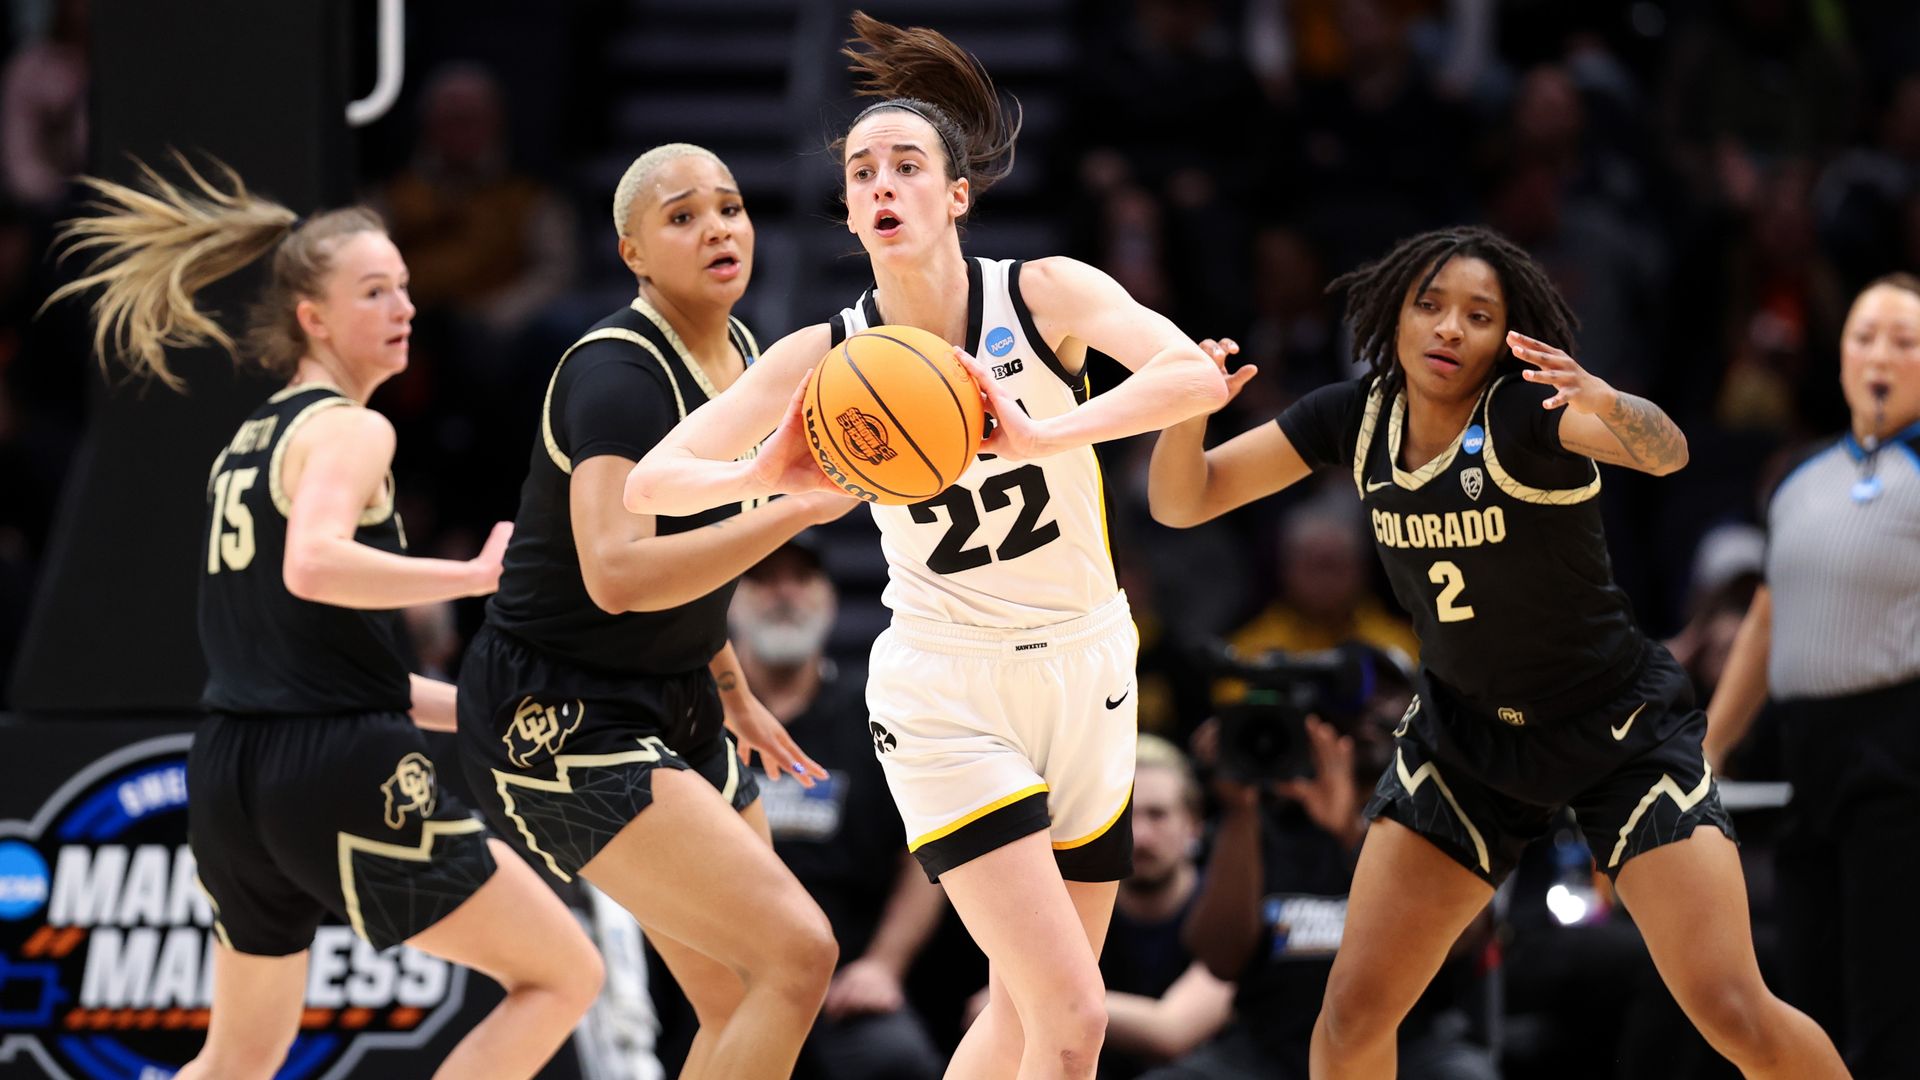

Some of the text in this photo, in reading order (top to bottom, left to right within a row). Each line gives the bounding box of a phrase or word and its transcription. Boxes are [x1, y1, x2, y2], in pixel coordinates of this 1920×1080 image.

[991, 336, 1014, 352] NCAA
[207, 466, 258, 574] 15
[908, 464, 1061, 574] 22
[1372, 505, 1506, 548] COLORADO
[1427, 561, 1475, 622] 2
[48, 844, 214, 928] MAR
[80, 926, 447, 1008] MAESS
